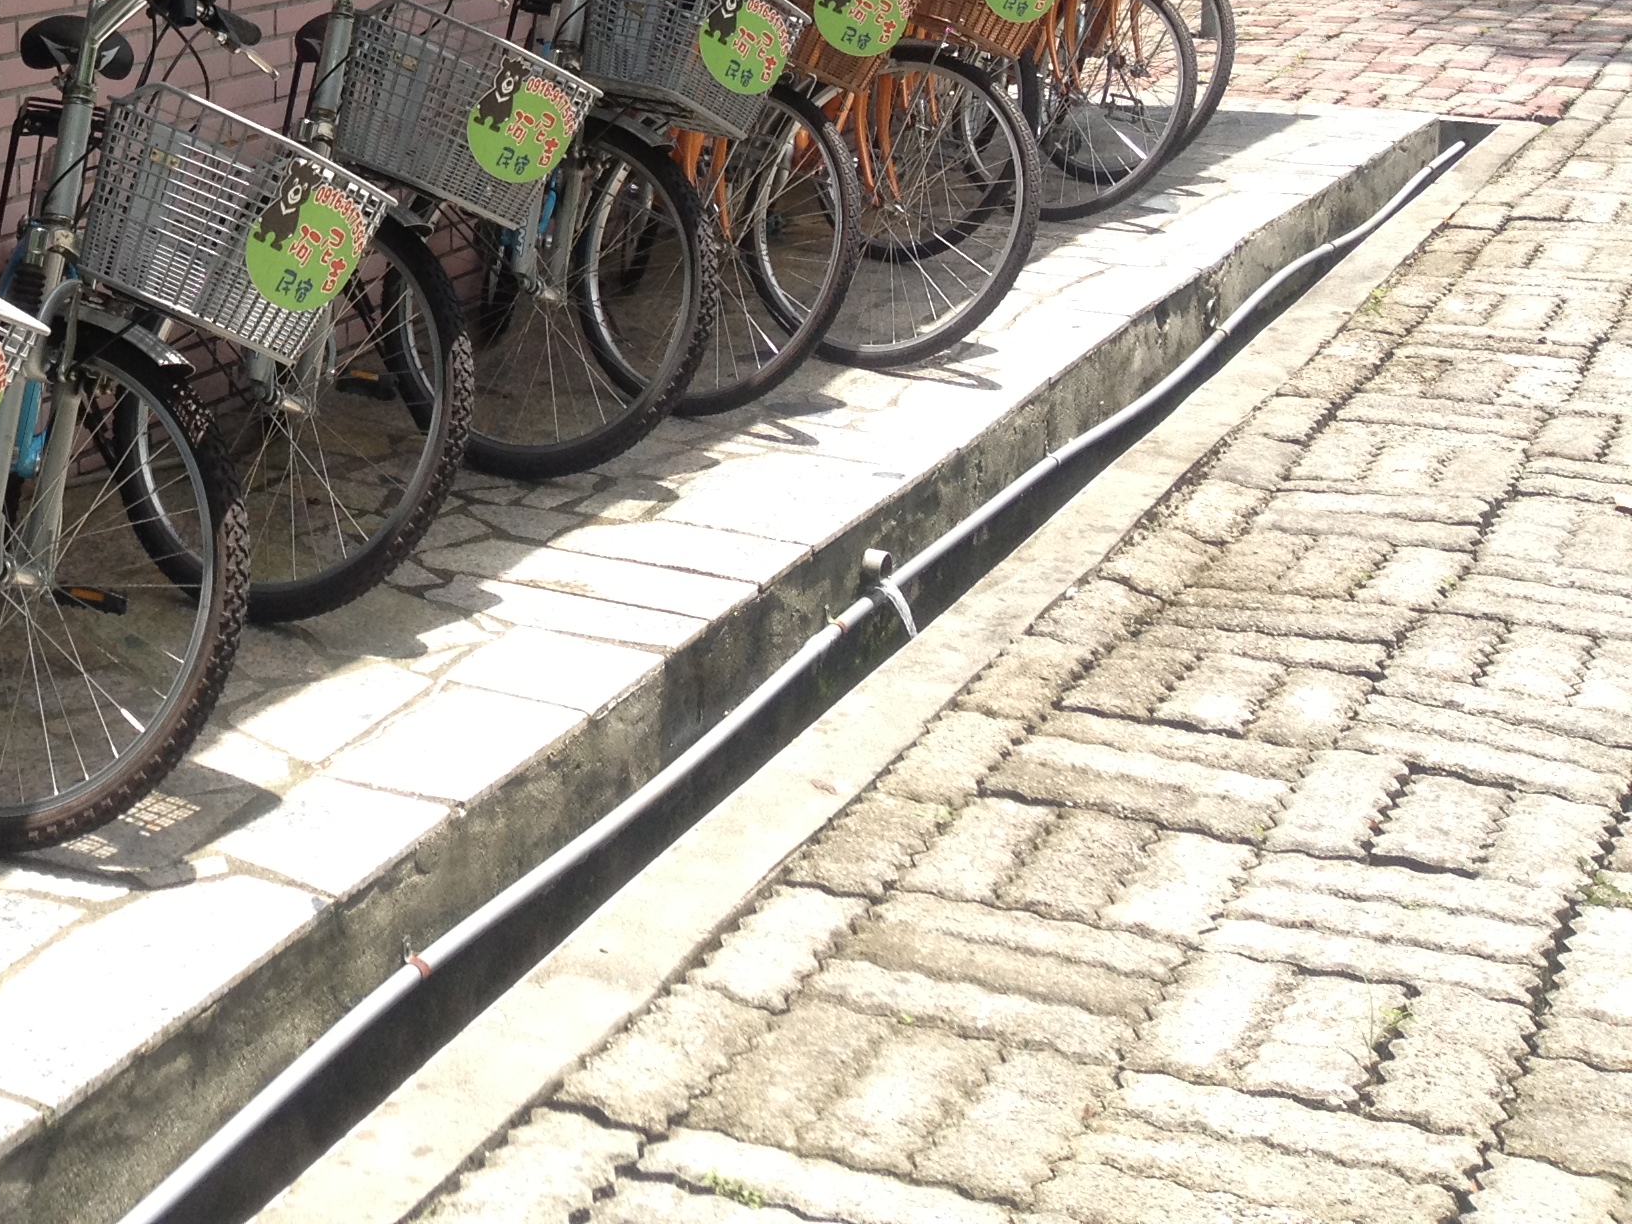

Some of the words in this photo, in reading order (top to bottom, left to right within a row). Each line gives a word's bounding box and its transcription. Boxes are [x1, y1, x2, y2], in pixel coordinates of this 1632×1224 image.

[840, 26, 871, 51] 民宿
[725, 59, 754, 88] 民宿
[496, 147, 530, 175] 民宿
[314, 184, 367, 257] 0916-917595
[275, 269, 313, 303] 民宿
